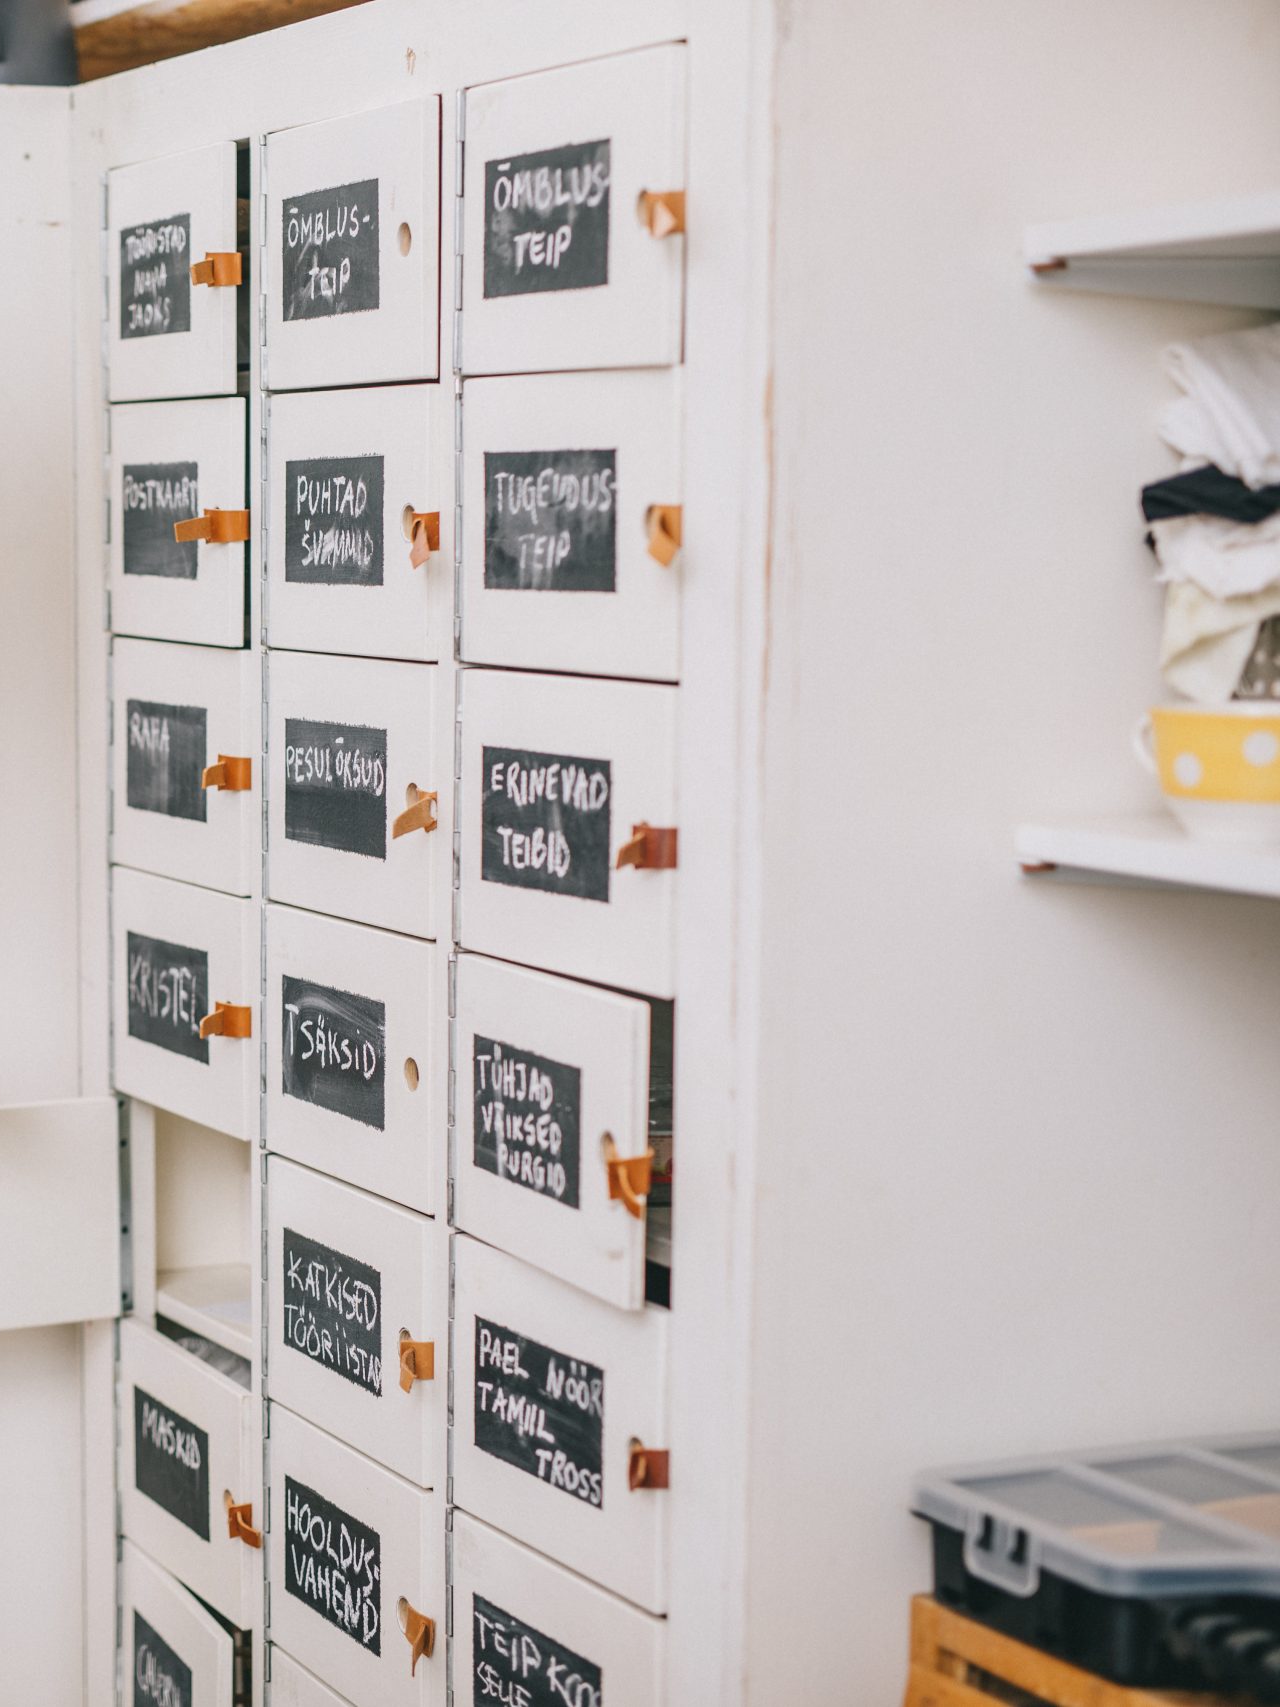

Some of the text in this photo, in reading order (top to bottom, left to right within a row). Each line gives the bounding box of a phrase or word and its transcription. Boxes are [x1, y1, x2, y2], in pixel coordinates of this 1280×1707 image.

[514, 224, 572, 270] TEIP
[308, 254, 350, 300] TEIP
[296, 475, 367, 518] PUHTAD
[518, 530, 571, 569] TEIP
[491, 761, 608, 812] ERINEVAD
[496, 825, 570, 878] TEIBID
[130, 953, 200, 1034] KRISTEL
[477, 1043, 553, 1111] TÜHJAD
[479, 1329, 602, 1417] PAEL NÖÖR
[142, 1402, 201, 1470] MASKID
[536, 1449, 603, 1504] TROSS
[475, 1611, 541, 1678] TEIP
